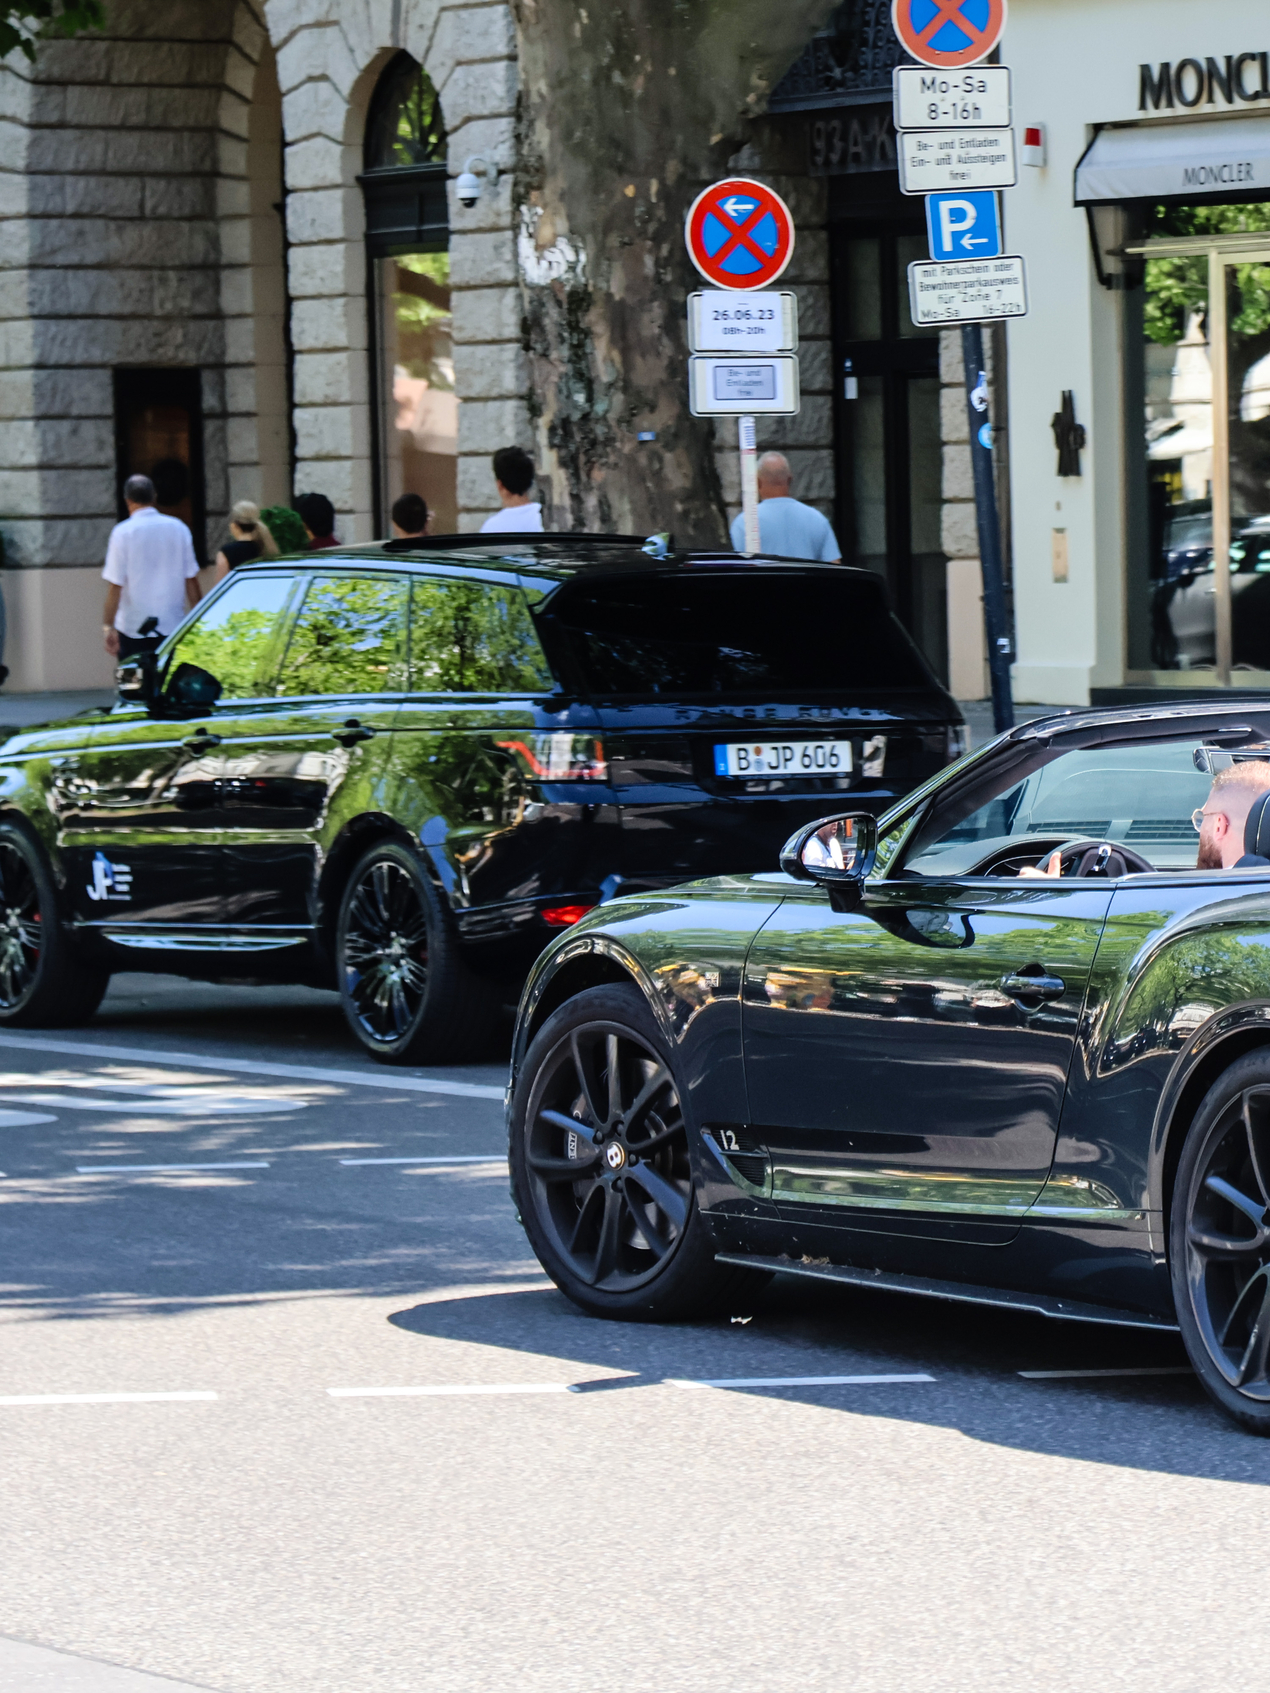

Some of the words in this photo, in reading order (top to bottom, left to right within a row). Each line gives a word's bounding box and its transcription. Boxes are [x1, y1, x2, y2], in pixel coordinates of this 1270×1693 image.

[920, 75, 987, 94] Mo-Sa
[927, 103, 982, 120] 8-16h
[916, 140, 934, 152] Be-
[938, 139, 955, 150] und
[959, 137, 999, 149] Entladen
[910, 156, 931, 168] Ein-
[935, 154, 952, 166] und
[957, 153, 1006, 166] Aussteigen
[949, 169, 972, 181] frei
[1181, 162, 1255, 187] MONCLER
[938, 199, 978, 252] P
[922, 267, 937, 278] mit
[940, 263, 989, 276] Parkschein
[993, 262, 1014, 273] oder
[919, 275, 1020, 292] Bewohnerparkausweis
[961, 292, 991, 303] Zone
[995, 289, 1003, 300] 7
[712, 309, 775, 321] 26.06.23
[921, 307, 960, 319] Mo-Sa
[736, 747, 751, 772] B
[767, 746, 795, 771] JP
[801, 744, 841, 769] 606
[720, 1129, 740, 1151] 12
